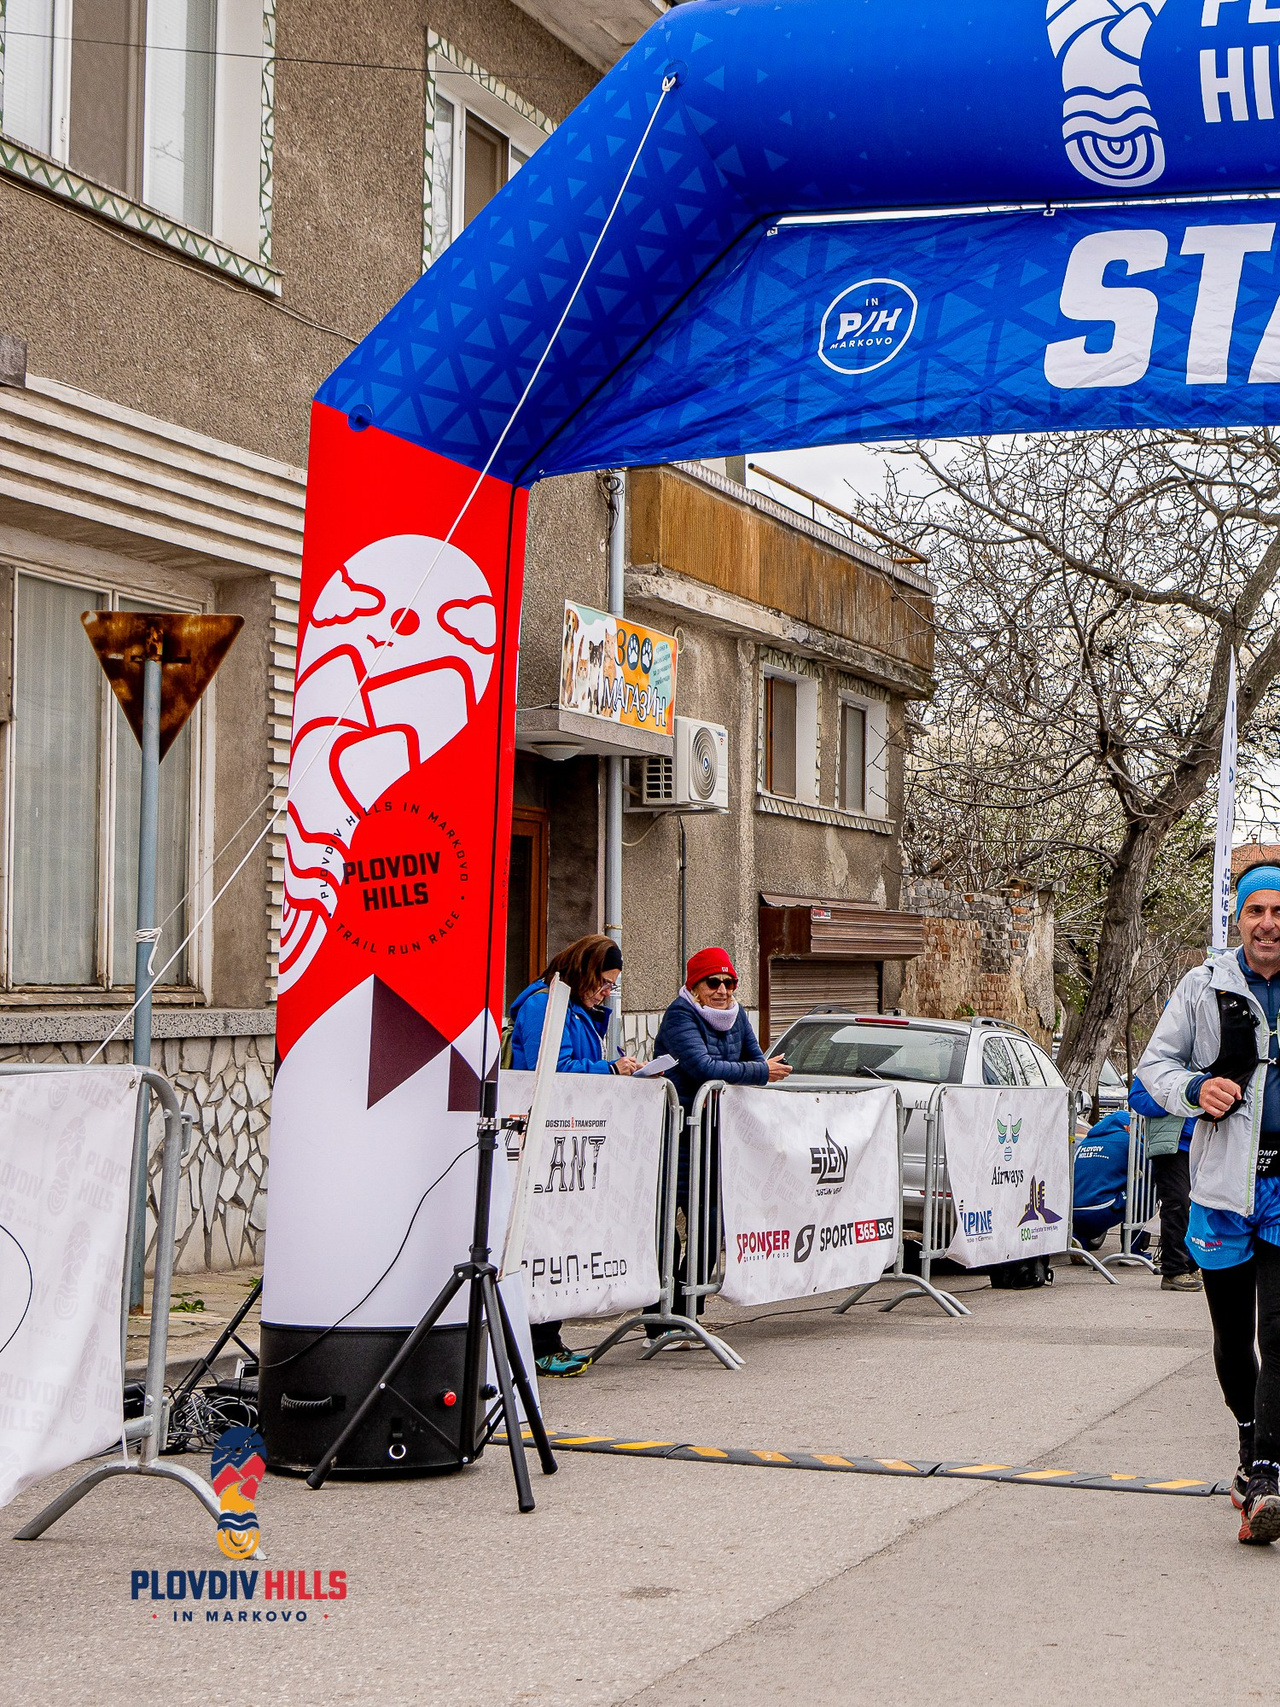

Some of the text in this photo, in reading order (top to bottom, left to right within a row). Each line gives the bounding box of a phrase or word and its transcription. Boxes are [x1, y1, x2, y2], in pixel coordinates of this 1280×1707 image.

[865, 297, 879, 306] IN
[836, 307, 903, 340] P/H
[829, 336, 893, 350] MARKOVO
[602, 676, 667, 727] МАГАЗИН
[319, 801, 468, 900] PLOVDIV HILLS IN MARKOVO
[342, 851, 441, 885] PLOVDIV
[362, 882, 429, 912] HILLS
[336, 910, 460, 955] TRAIL RUN RACE
[574, 1119, 607, 1128] TRANSPORT
[534, 1135, 607, 1193] ANT
[991, 1166, 1024, 1188] Airways
[1259, 1157, 1272, 1165] SS
[736, 1230, 790, 1264] SPONSER
[819, 1222, 853, 1252] SPORT
[856, 1218, 894, 1243] 365.BG
[1020, 1227, 1031, 1242] ECO
